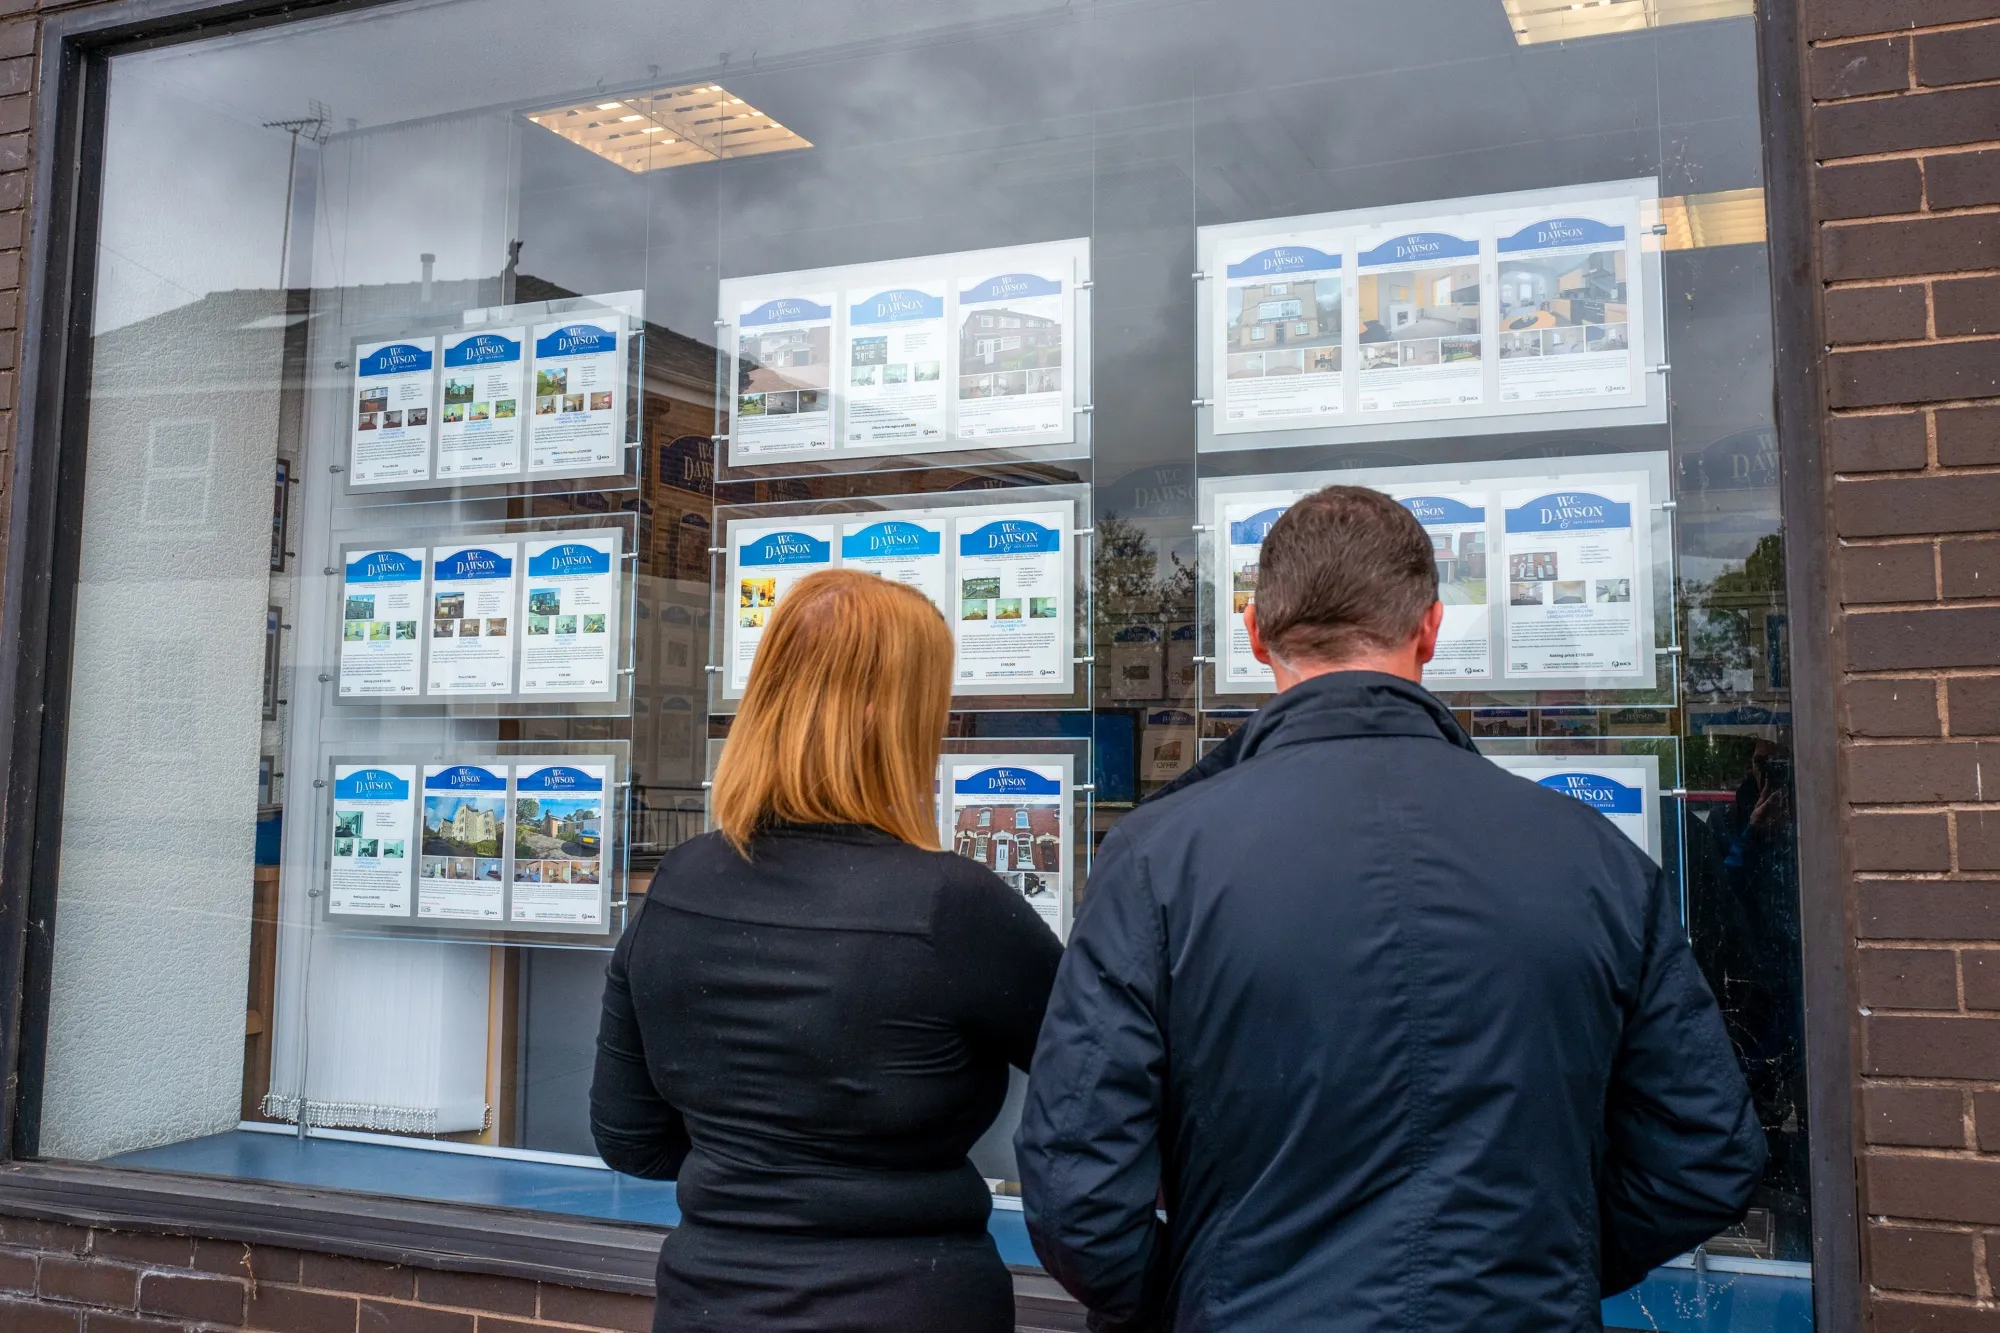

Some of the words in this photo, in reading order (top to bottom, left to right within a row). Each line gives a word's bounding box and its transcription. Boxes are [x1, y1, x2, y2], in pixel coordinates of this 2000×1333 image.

[1538, 228, 1583, 243] DAWSON
[1397, 242, 1440, 257] DAWSON
[1264, 256, 1304, 270] DAWSON
[877, 300, 923, 317] DAWSON
[559, 335, 600, 350] DAWSON
[466, 345, 504, 360] DAWSON
[380, 354, 416, 369] DAWSON
[1410, 507, 1444, 516] AWSON
[1540, 506, 1603, 524] DAWSON
[870, 535, 919, 550] DAWSON
[988, 532, 1038, 548] DAWSON
[765, 544, 810, 559] DAWSON
[368, 562, 405, 576] DAWSON
[456, 560, 495, 574] DAWSON
[552, 556, 592, 569] DAWSON
[451, 775, 480, 784] DAWSON
[545, 777, 575, 786] DAWSON
[988, 778, 1026, 789] DAWSON
[1566, 777, 1591, 788] W.C.
[356, 781, 393, 794] DAWSON
